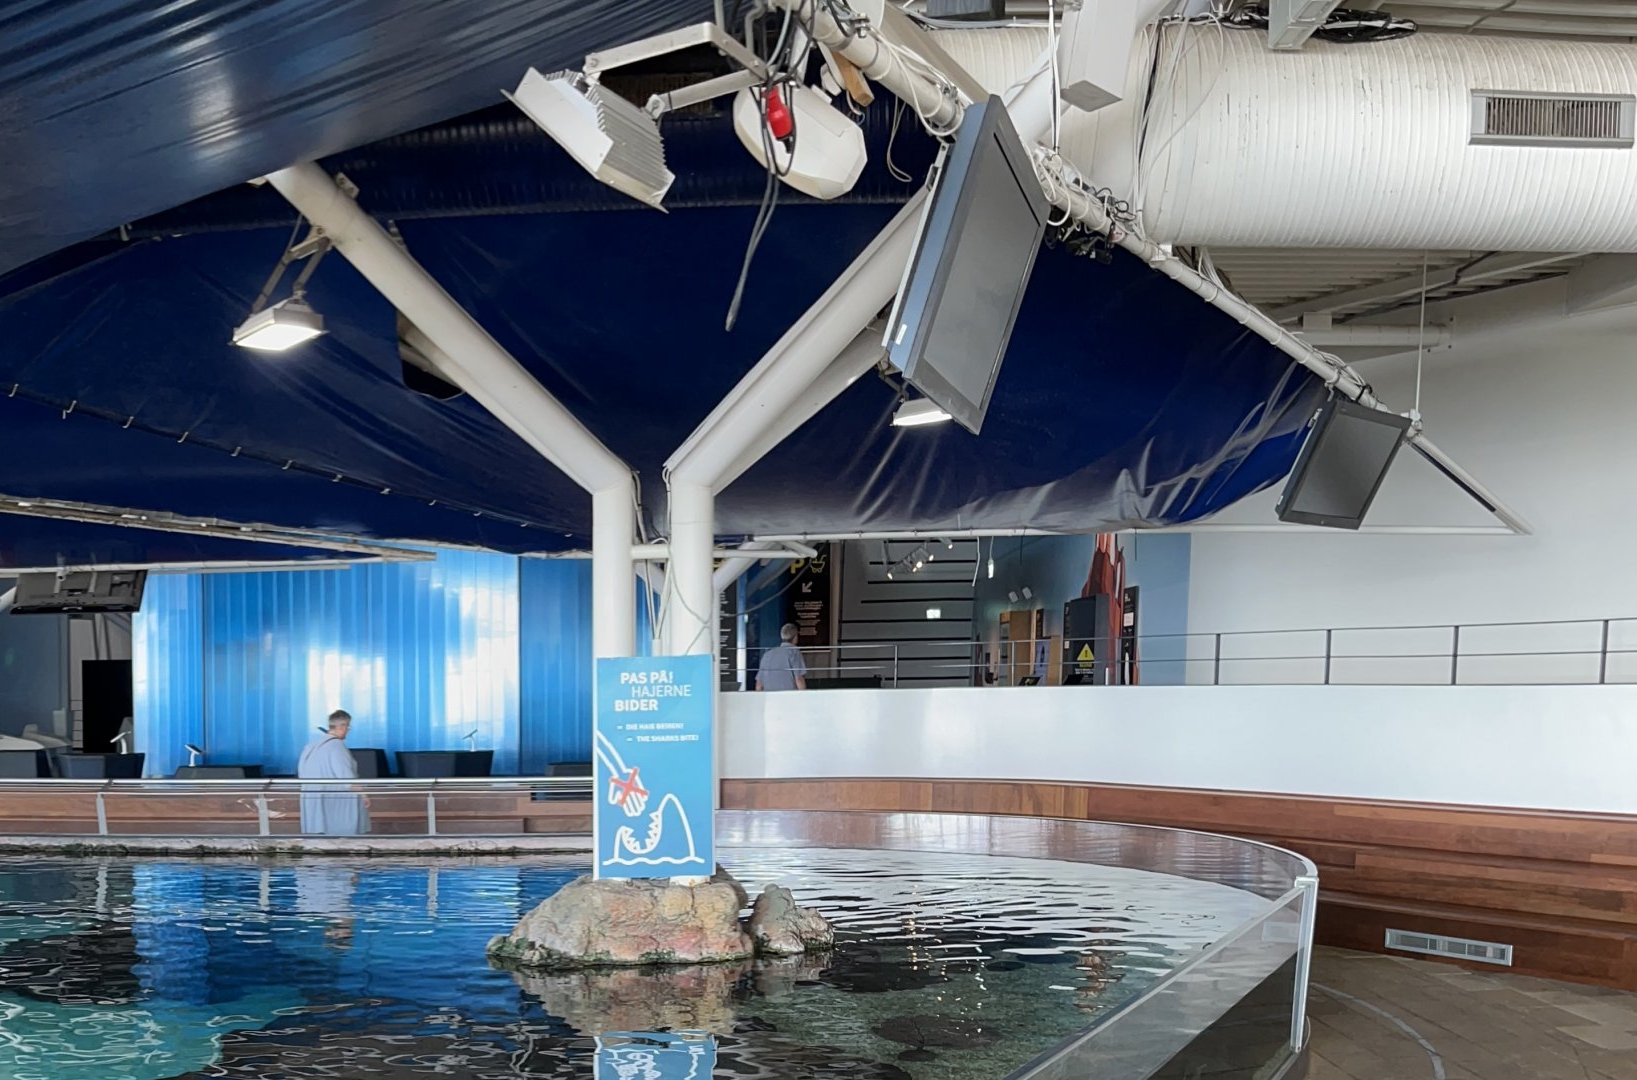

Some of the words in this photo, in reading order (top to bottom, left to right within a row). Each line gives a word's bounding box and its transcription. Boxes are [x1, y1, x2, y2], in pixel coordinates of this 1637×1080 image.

[620, 672, 648, 684] PAS
[650, 670, 674, 684] PÅ!
[631, 685, 692, 697] HAJERNE
[614, 699, 659, 712] BIDER
